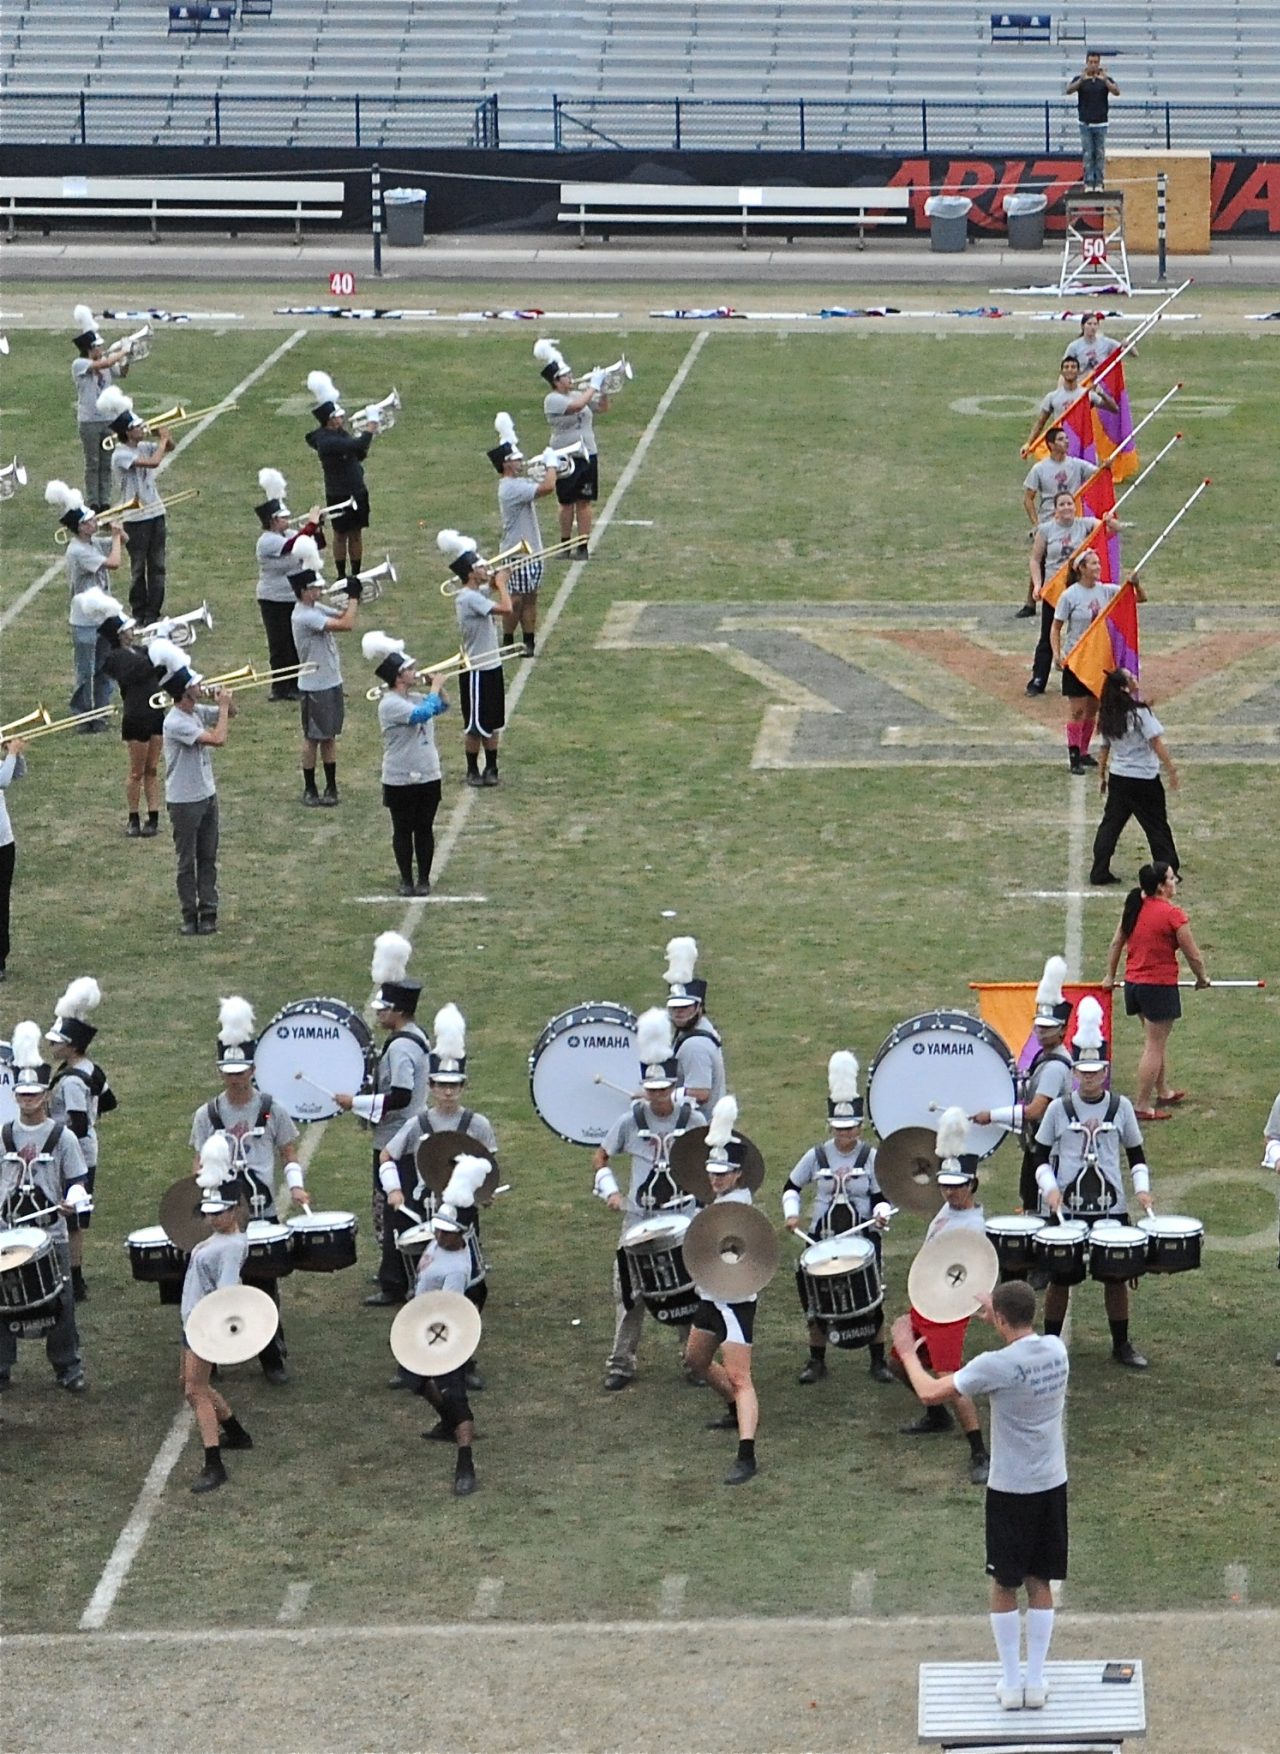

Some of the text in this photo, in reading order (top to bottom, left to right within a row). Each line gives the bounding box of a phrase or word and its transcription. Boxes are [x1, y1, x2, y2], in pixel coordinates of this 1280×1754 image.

[1083, 238, 1104, 257] 50
[331, 273, 353, 294] 40
[292, 1026, 340, 1040] YAMAHA
[582, 1035, 630, 1049] YAMAHA
[927, 1042, 974, 1056] YAMAHA
[670, 1303, 700, 1320] YAMA
